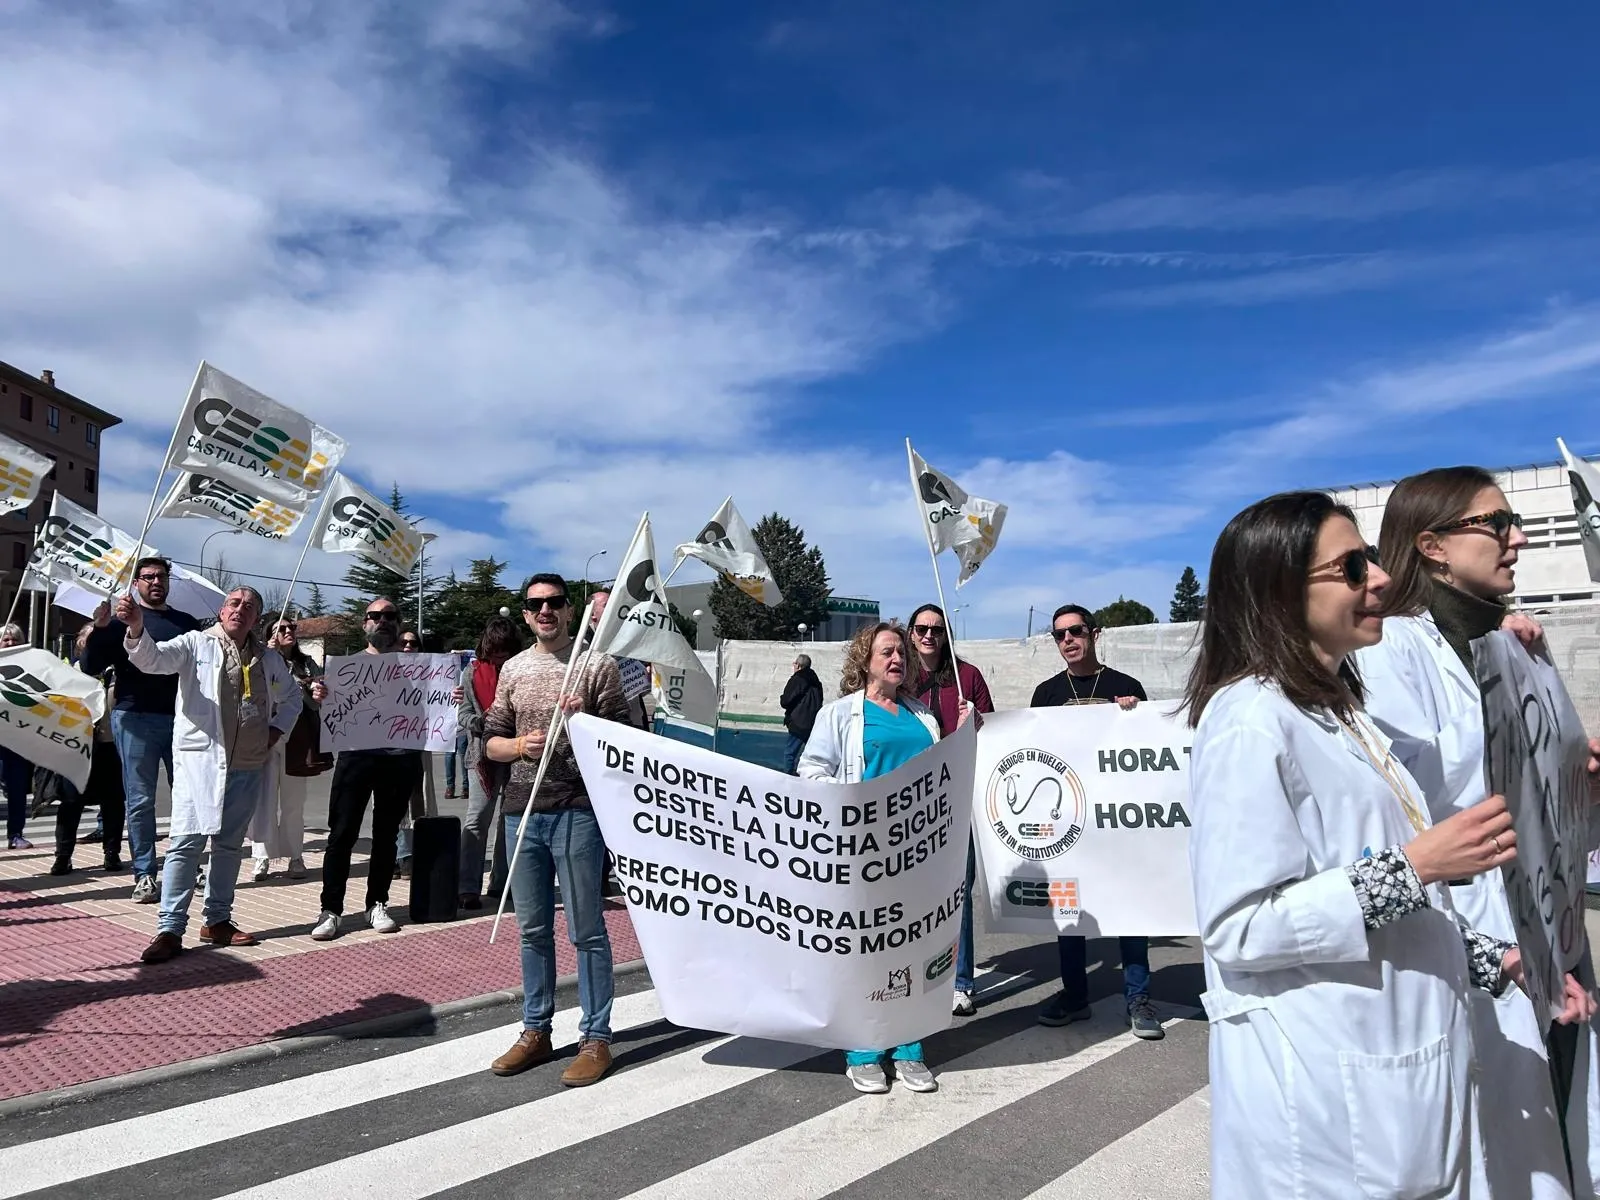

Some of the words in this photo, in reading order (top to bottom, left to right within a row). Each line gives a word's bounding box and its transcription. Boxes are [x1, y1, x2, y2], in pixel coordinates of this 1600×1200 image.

[187, 434, 257, 473] CASTILLA
[178, 493, 237, 521] CASTILLA
[237, 518, 246, 526] y
[337, 660, 385, 687] SIN
[621, 671, 646, 686] ORNADA
[623, 680, 645, 693] ABORAL
[396, 687, 422, 707] NO
[36, 725, 92, 761] LEÓN
[383, 714, 448, 742] PARAR
[1026, 751, 1036, 762] EN
[1037, 752, 1067, 775] HUELGA
[1098, 747, 1180, 773] HORA
[597, 739, 635, 774] "DE
[643, 756, 727, 800] NORTE
[736, 785, 756, 808] A
[764, 792, 830, 829] SUR,
[841, 800, 877, 827] DE
[887, 771, 933, 818] ESTE
[938, 762, 951, 787] A
[633, 783, 724, 826] OESTE.
[732, 810, 766, 840] LA
[774, 823, 880, 856] LUCHA
[888, 792, 952, 847] SIGUE,
[1094, 802, 1191, 829] HORA
[633, 811, 735, 856] CUESTE
[744, 841, 779, 869] LO
[788, 856, 850, 885] QUE
[861, 816, 953, 883] CUESTE"
[994, 820, 1009, 839] POR
[1006, 835, 1018, 849] UN
[1017, 824, 1081, 859] #ESTATUTOPROPIO
[745, 884, 904, 930] LABORALES
[1006, 880, 1078, 908] CESM
[697, 899, 791, 942] TODOS
[798, 929, 852, 955] LOS
